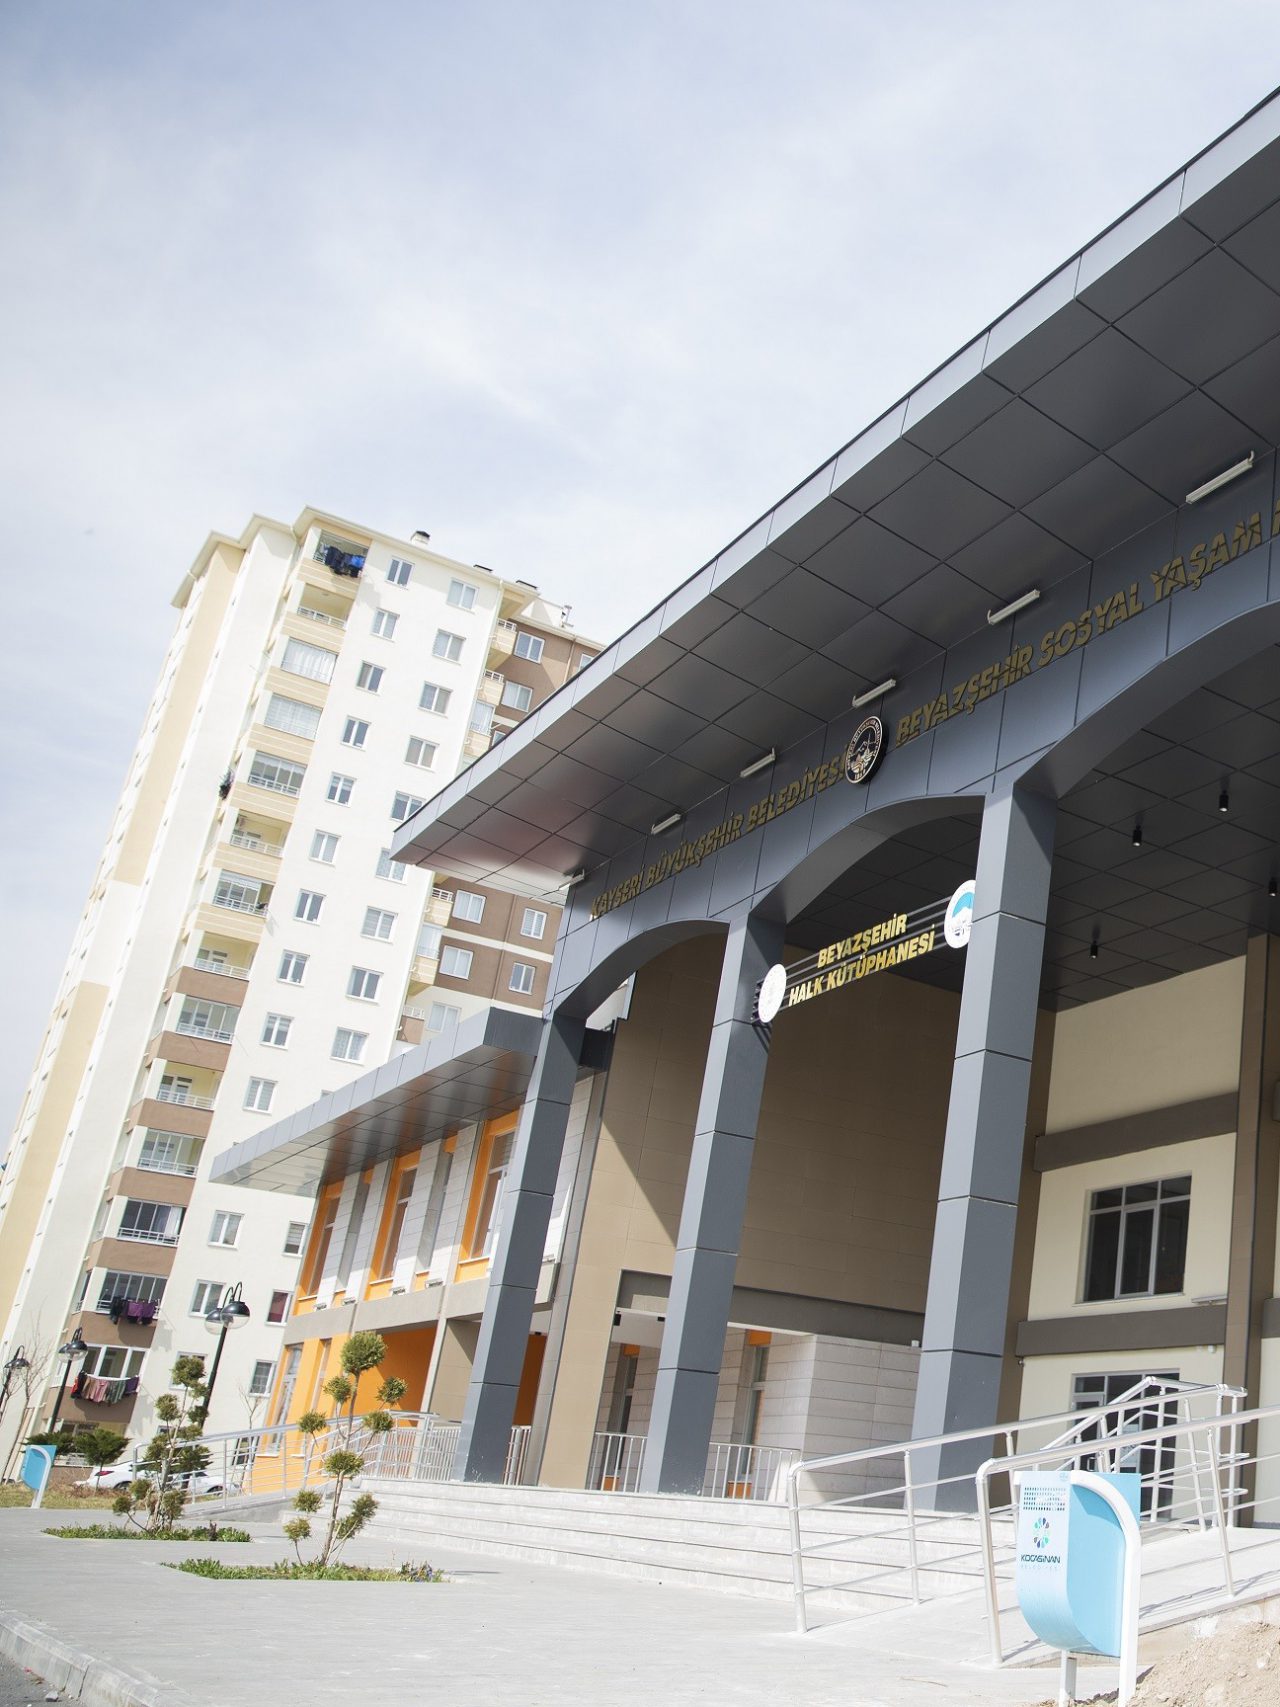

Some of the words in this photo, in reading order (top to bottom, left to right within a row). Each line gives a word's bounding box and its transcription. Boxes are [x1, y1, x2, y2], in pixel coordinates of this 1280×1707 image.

[896, 644, 1034, 747] BEYAZŞEHİR
[1038, 582, 1144, 667] SOSYAL
[1151, 512, 1262, 600] YAŞAM
[589, 863, 646, 921] KAYSERİ
[645, 811, 744, 889] BÜYÜKŞEHİR
[788, 977, 825, 1007] HALK
[826, 924, 936, 991] KÜTÜPHANESİ
[817, 913, 909, 969] BEYAZŞEHİR
